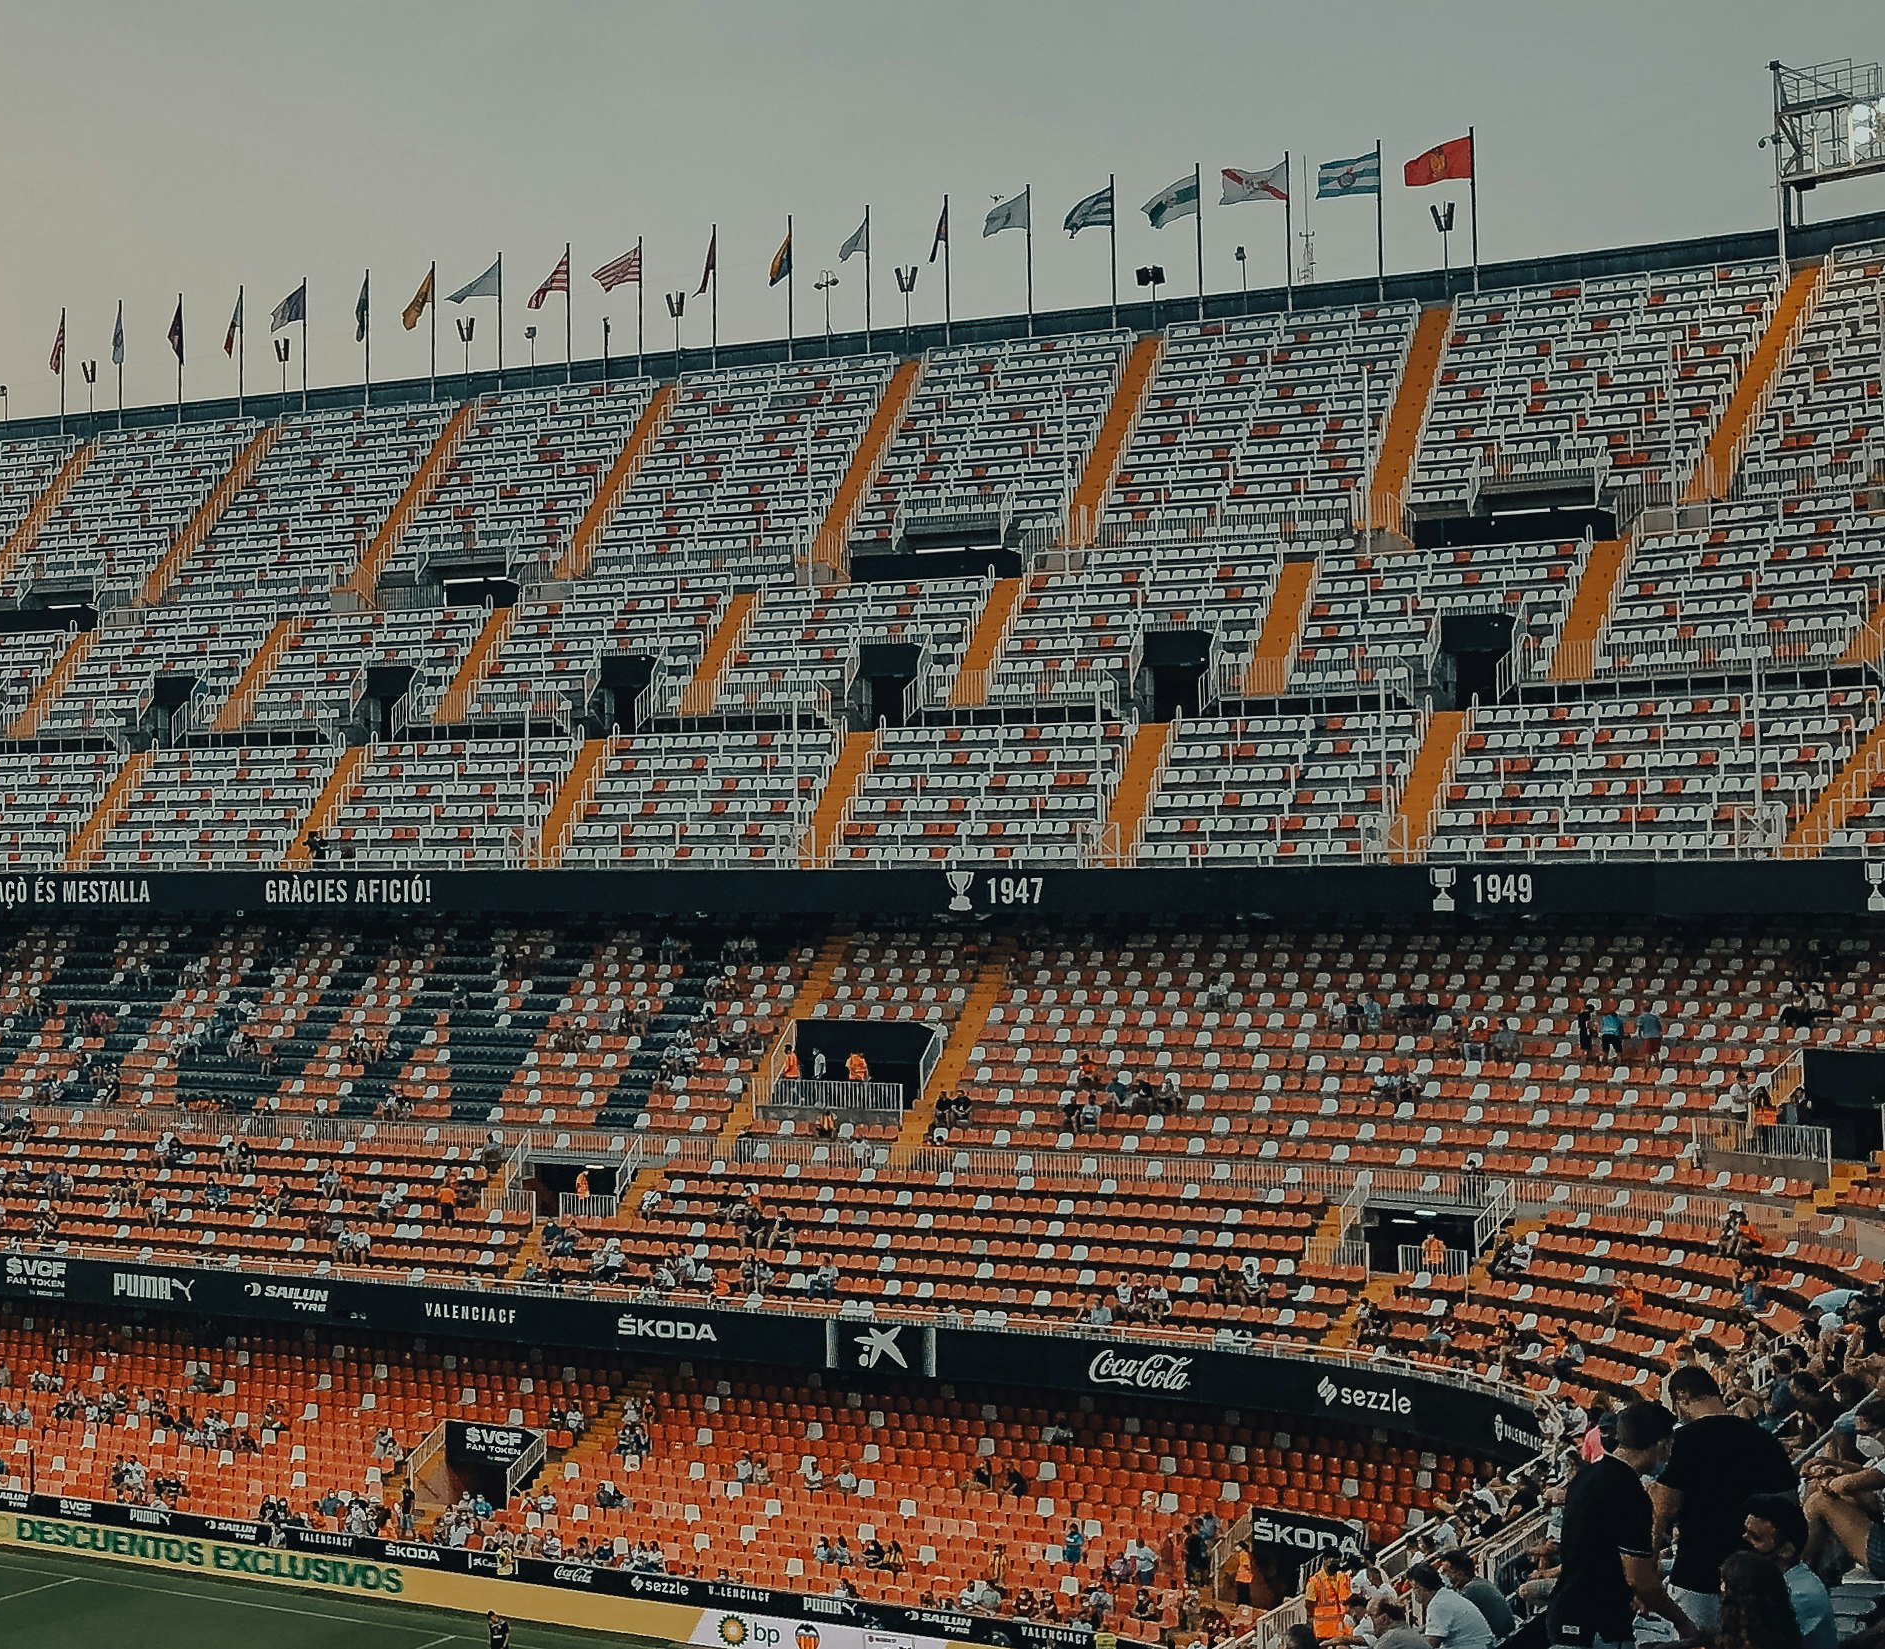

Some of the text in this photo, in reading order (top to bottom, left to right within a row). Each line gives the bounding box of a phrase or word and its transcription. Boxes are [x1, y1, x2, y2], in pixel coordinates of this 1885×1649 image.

[34, 876, 55, 902] ÉS
[62, 880, 151, 903] MESTALLA
[265, 875, 432, 903] GRÀCIES AFICIÓ!
[986, 877, 1044, 905] 1947
[1473, 874, 1534, 903] 1949
[6, 1256, 67, 1277] $VCF
[6, 1276, 65, 1288] FAN TOKEN
[113, 1272, 174, 1300] PUMA
[264, 1286, 329, 1302] SAILUN
[293, 1301, 326, 1313] TYRE
[618, 1314, 717, 1341] ŠKODA
[1089, 1349, 1193, 1390] Coca-Cola
[1341, 1387, 1412, 1415] sezzle
[465, 1427, 522, 1446] $VCF
[466, 1443, 521, 1455] FAN TOKEN
[217, 1521, 257, 1534] SAILUN
[15, 1517, 404, 1593] DESCUENTOS EXCLUSIVOS
[384, 1543, 440, 1562] ŠKODA
[645, 1581, 689, 1596] sezzle
[803, 1596, 843, 1615] PUMA
[921, 1613, 973, 1628] SAILUN
[753, 1622, 781, 1648] bp
